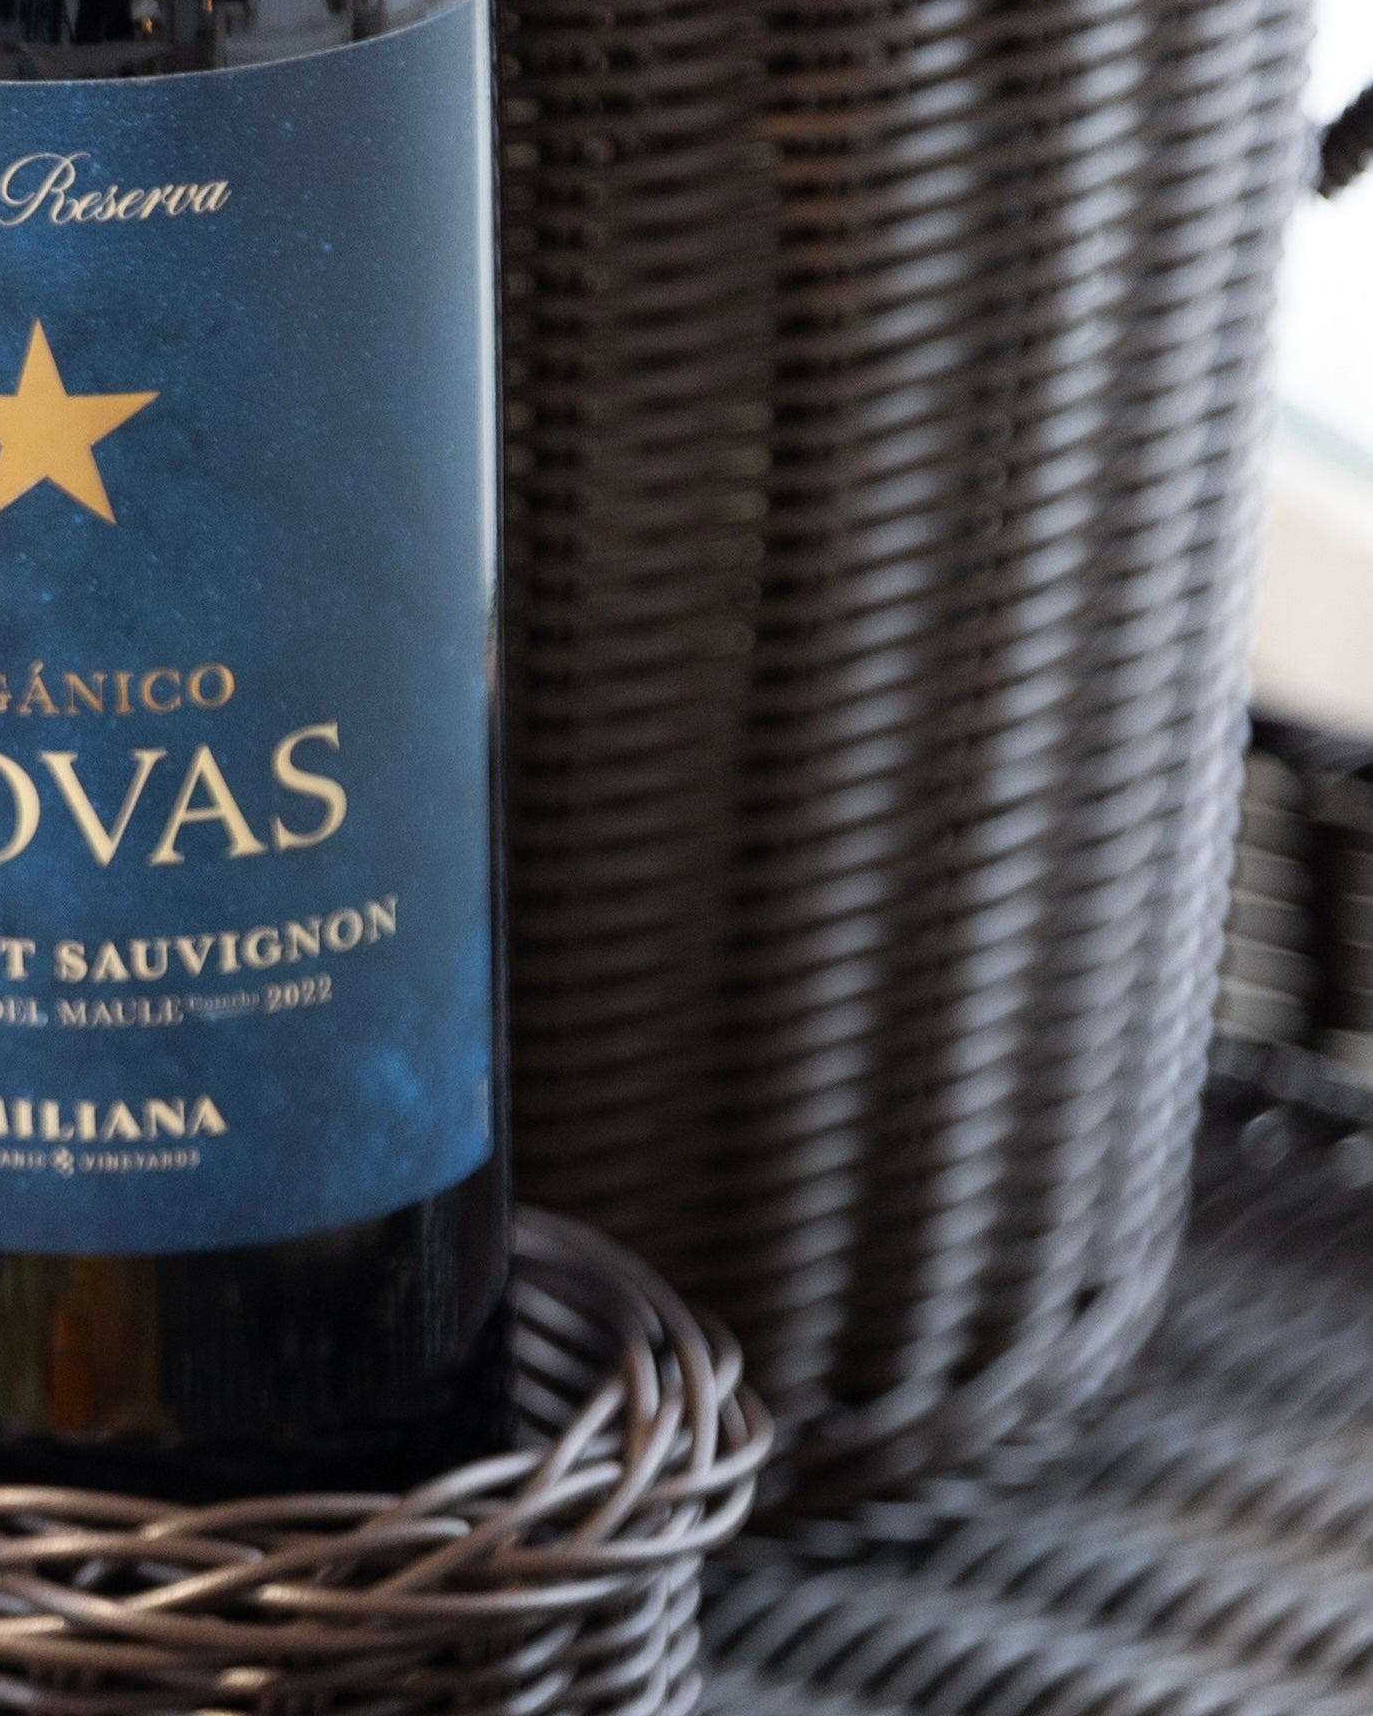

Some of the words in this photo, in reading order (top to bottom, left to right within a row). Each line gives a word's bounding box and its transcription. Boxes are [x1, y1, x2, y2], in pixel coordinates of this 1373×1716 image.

[56, 895, 399, 983] SAUVIGNON
[55, 995, 183, 1028] MAULE
[263, 972, 332, 1014] 2022
